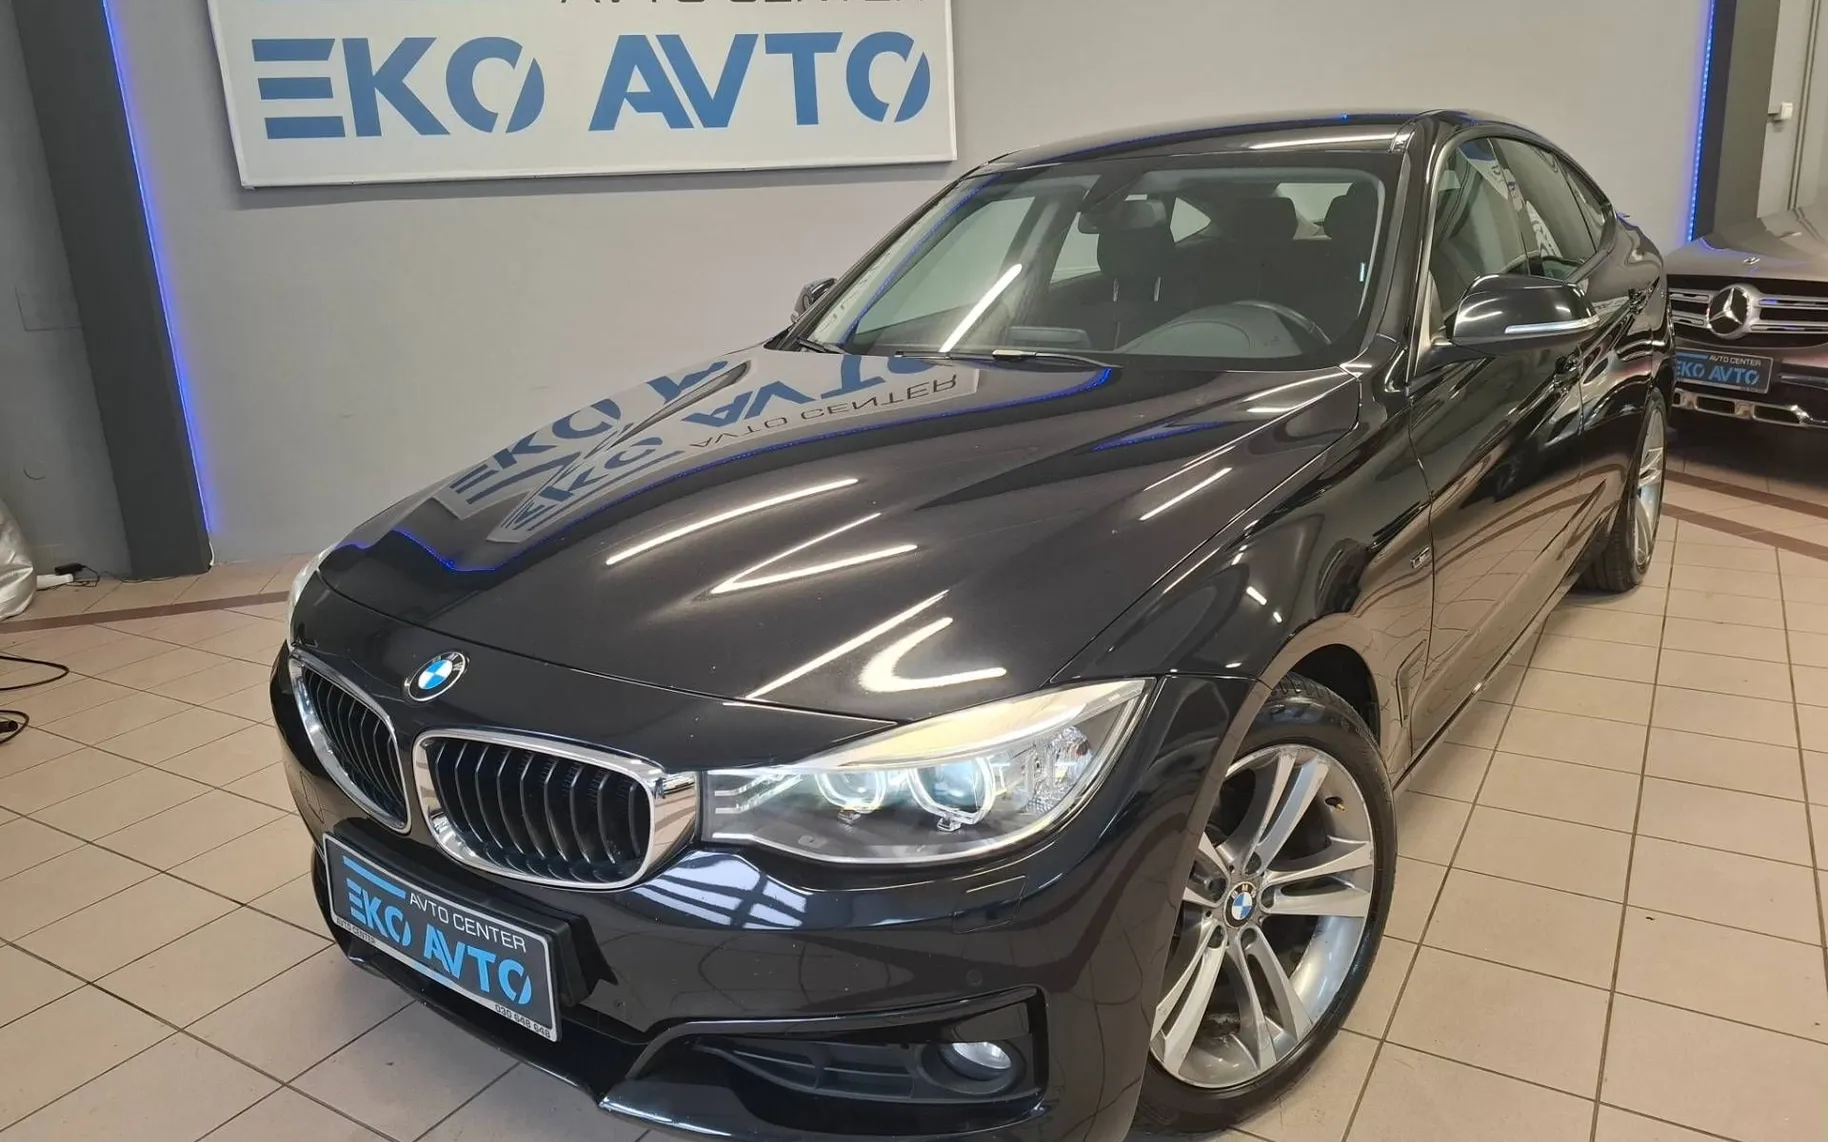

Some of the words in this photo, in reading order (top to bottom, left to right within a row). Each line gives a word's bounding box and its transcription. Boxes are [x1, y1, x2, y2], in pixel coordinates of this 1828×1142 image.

[250, 36, 546, 140] EKO
[588, 31, 932, 132] AVTO
[1709, 355, 1730, 364] AVTO
[1730, 357, 1762, 367] CENTER
[1709, 364, 1760, 386] AVTO
[346, 877, 412, 947] EKO
[423, 923, 533, 1005] AVTO
[409, 892, 450, 924] AVTO
[453, 913, 528, 953] CENTER
